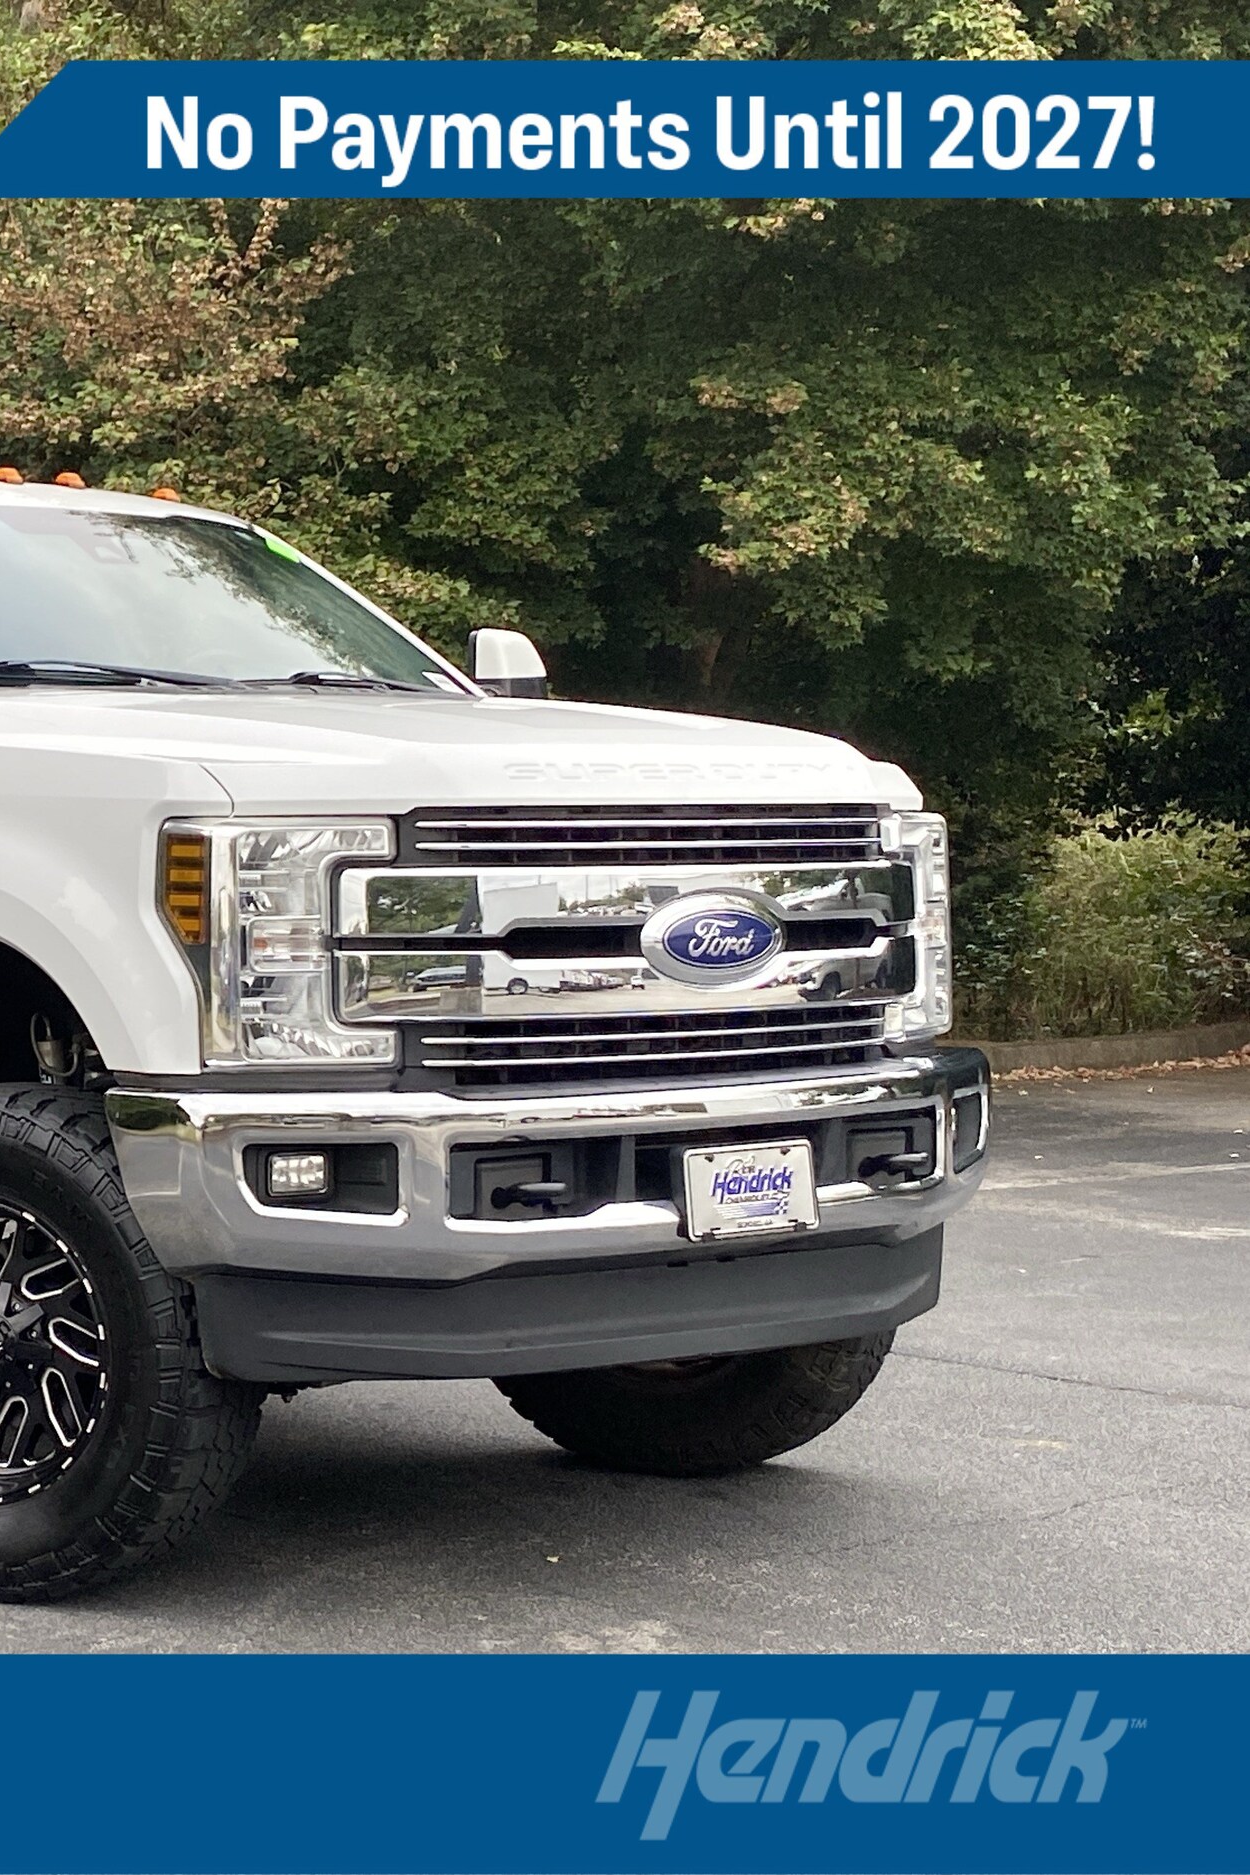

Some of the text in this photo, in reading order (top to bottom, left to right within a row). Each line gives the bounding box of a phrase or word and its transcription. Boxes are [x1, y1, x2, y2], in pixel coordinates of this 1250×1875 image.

[503, 762, 707, 782] SUPER
[688, 918, 755, 957] Ford
[711, 1166, 794, 1204] Hendrick
